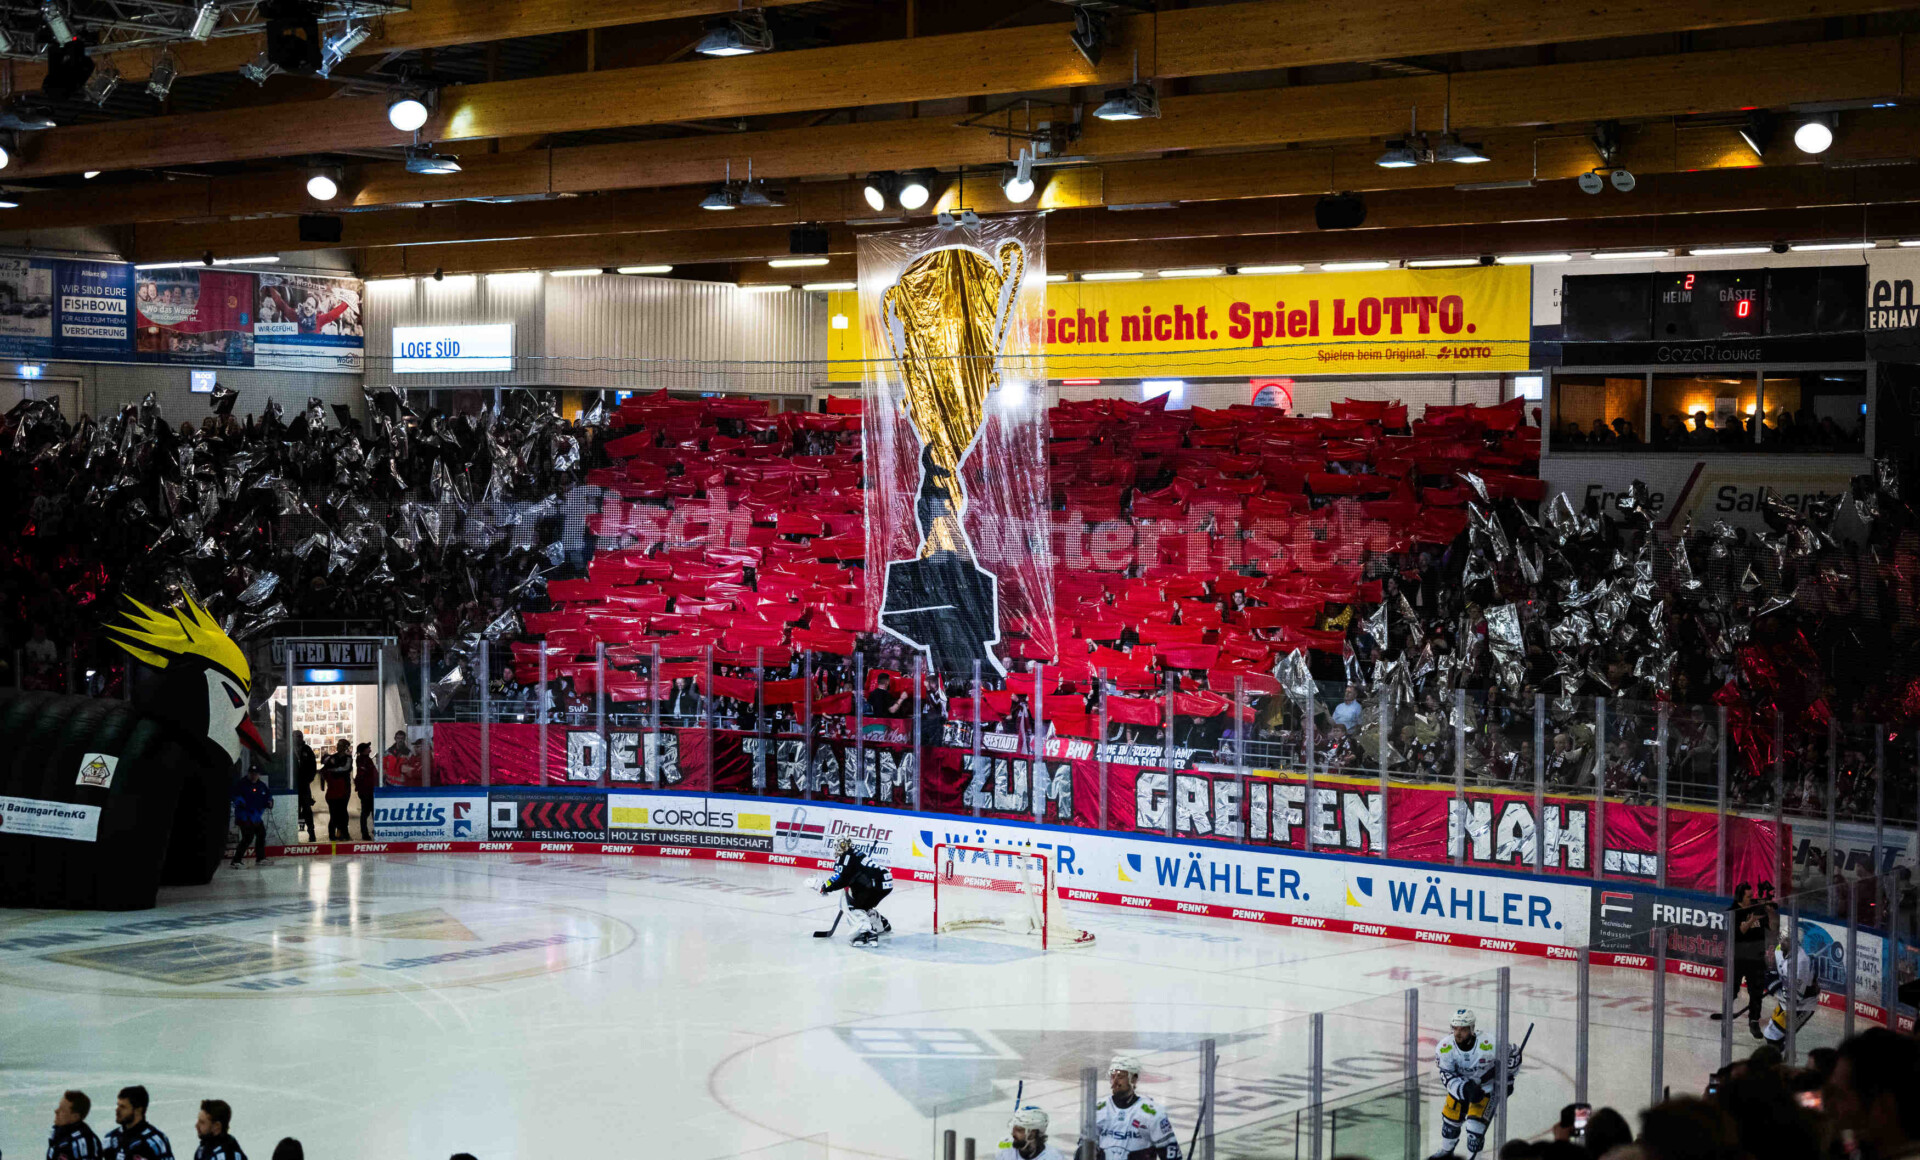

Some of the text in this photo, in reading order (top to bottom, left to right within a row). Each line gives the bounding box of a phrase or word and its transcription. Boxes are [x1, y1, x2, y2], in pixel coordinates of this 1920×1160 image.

[62, 284, 127, 297] WIR SIND EURE
[1684, 274, 1695, 290] 2
[1662, 287, 1757, 304] HEIM GÄSTE
[64, 299, 124, 312] FISHBOWL
[146, 305, 199, 315] Wo das Wasser
[1738, 300, 1750, 317] 0
[1034, 295, 1477, 347] icht nicht. Spiel LOTTO.
[1869, 308, 1919, 329] ERHAV
[65, 326, 125, 337] VERSICHERUNG
[401, 338, 460, 358] LOGE SÜD
[1317, 349, 1354, 363] Spielen
[1358, 348, 1382, 361] beim
[1453, 347, 1491, 359] LOTTO
[200, 379, 208, 390] 2
[329, 644, 351, 663] WE
[568, 703, 589, 713] swb
[567, 730, 682, 784] DER
[742, 737, 914, 804] TRAUM
[963, 753, 1073, 819] ZUM
[1136, 772, 1384, 853] GREIFEN
[1448, 798, 1588, 869] NAH
[374, 802, 446, 826] nuttis
[374, 829, 445, 838] Heizungstechnik
[831, 819, 893, 841] Döscher
[611, 831, 772, 849] HOLZ IST UNSERE LEIDENSCHAFT.
[1155, 851, 1310, 901] WÄHLER.
[1388, 875, 1563, 931] WÄHLER.
